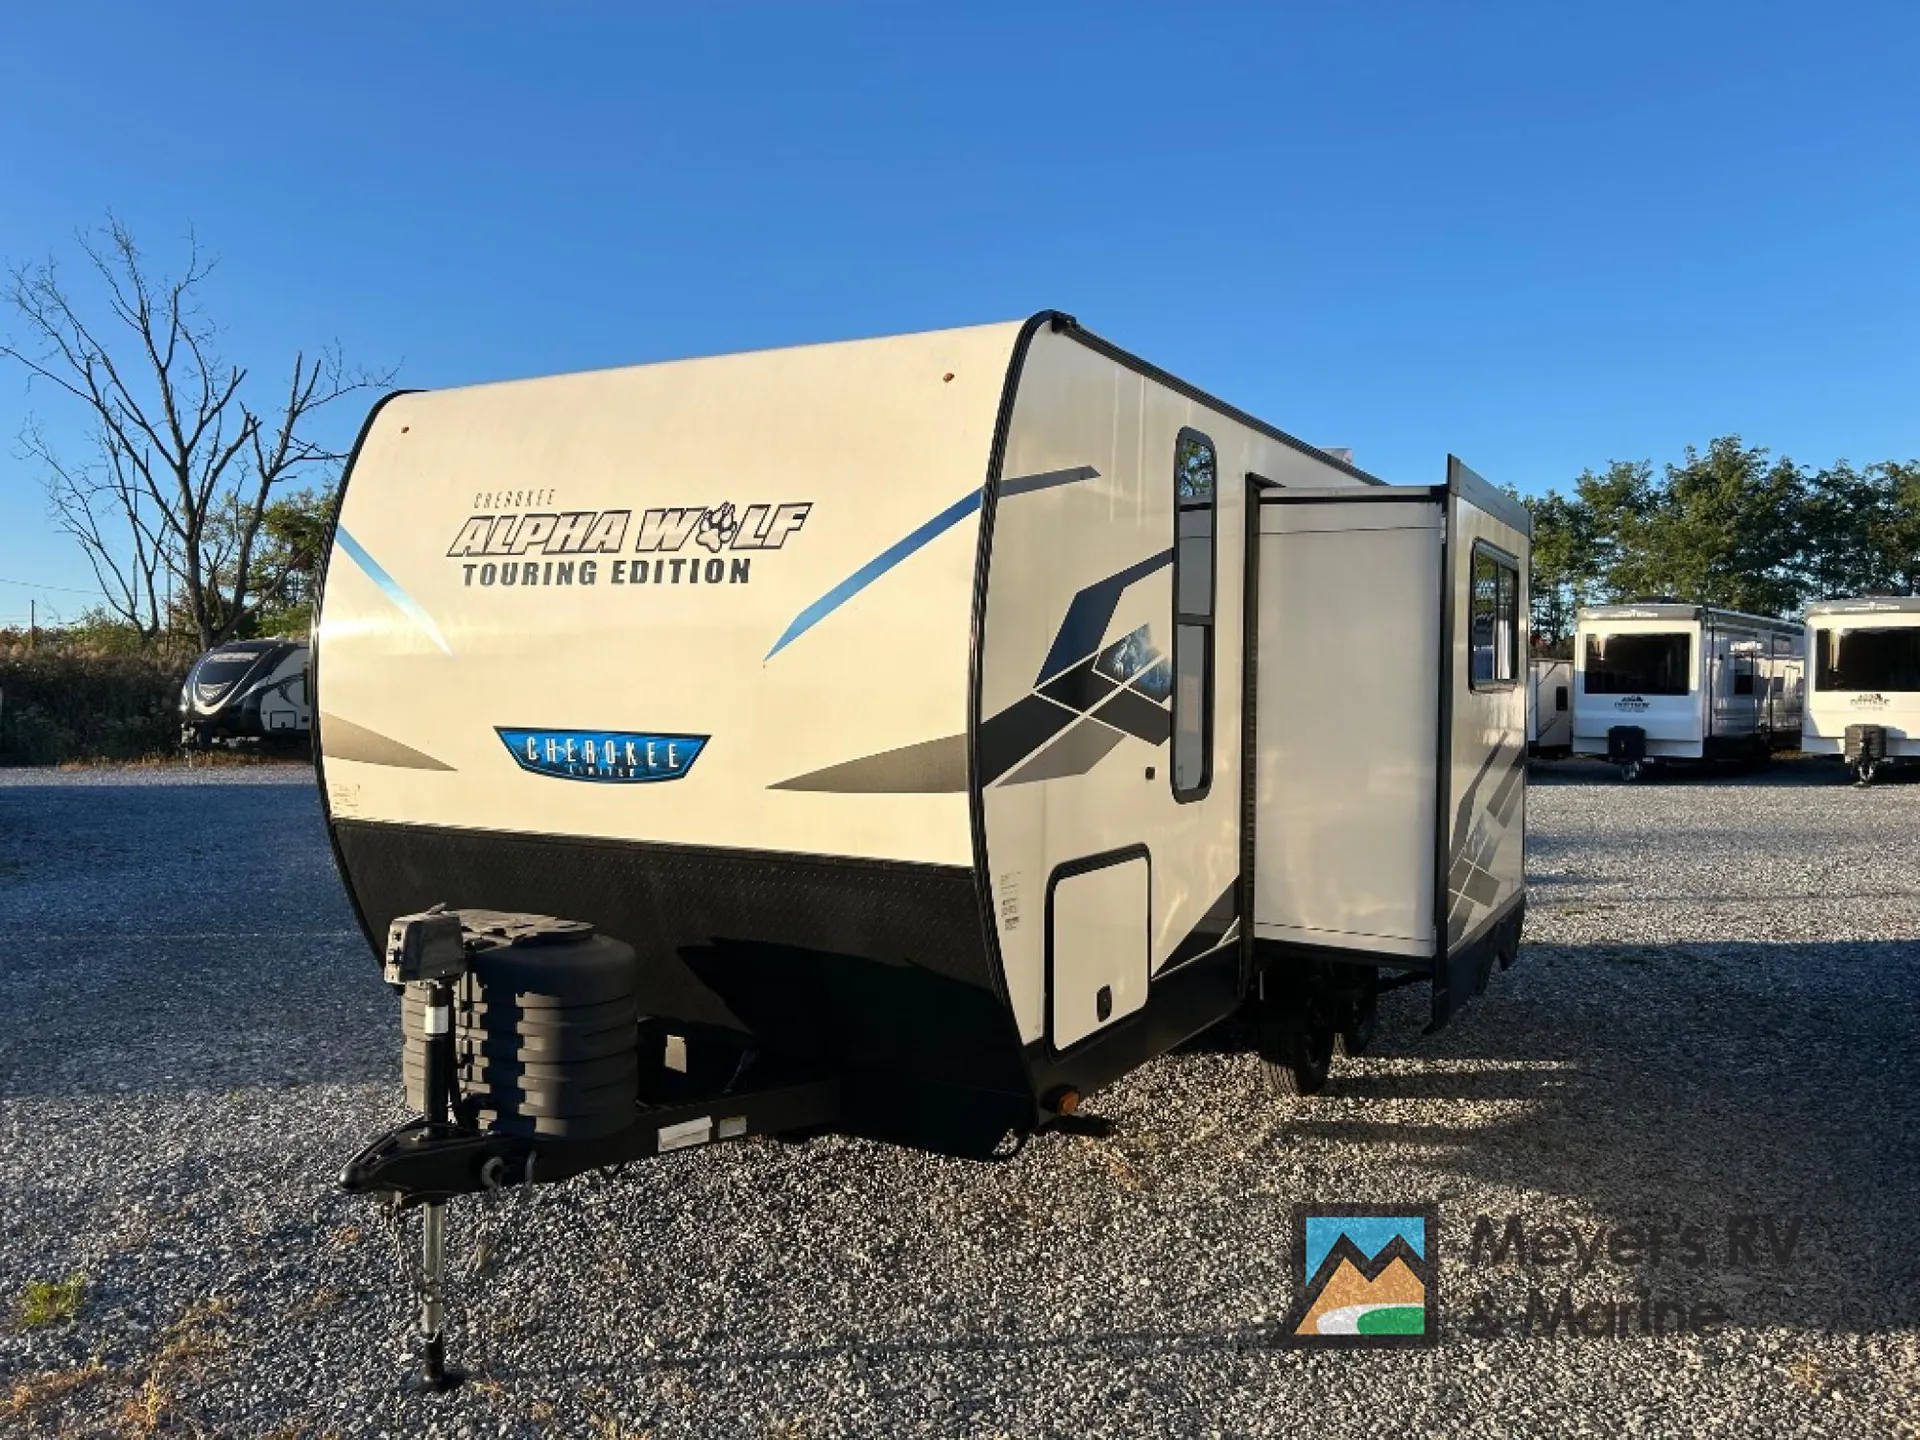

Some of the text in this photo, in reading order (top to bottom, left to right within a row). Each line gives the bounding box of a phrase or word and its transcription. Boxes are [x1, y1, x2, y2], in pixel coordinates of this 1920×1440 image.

[446, 510, 632, 557] ALPHA
[463, 558, 751, 587] TOURING EDITION
[526, 735, 680, 768] CHEROKEE
